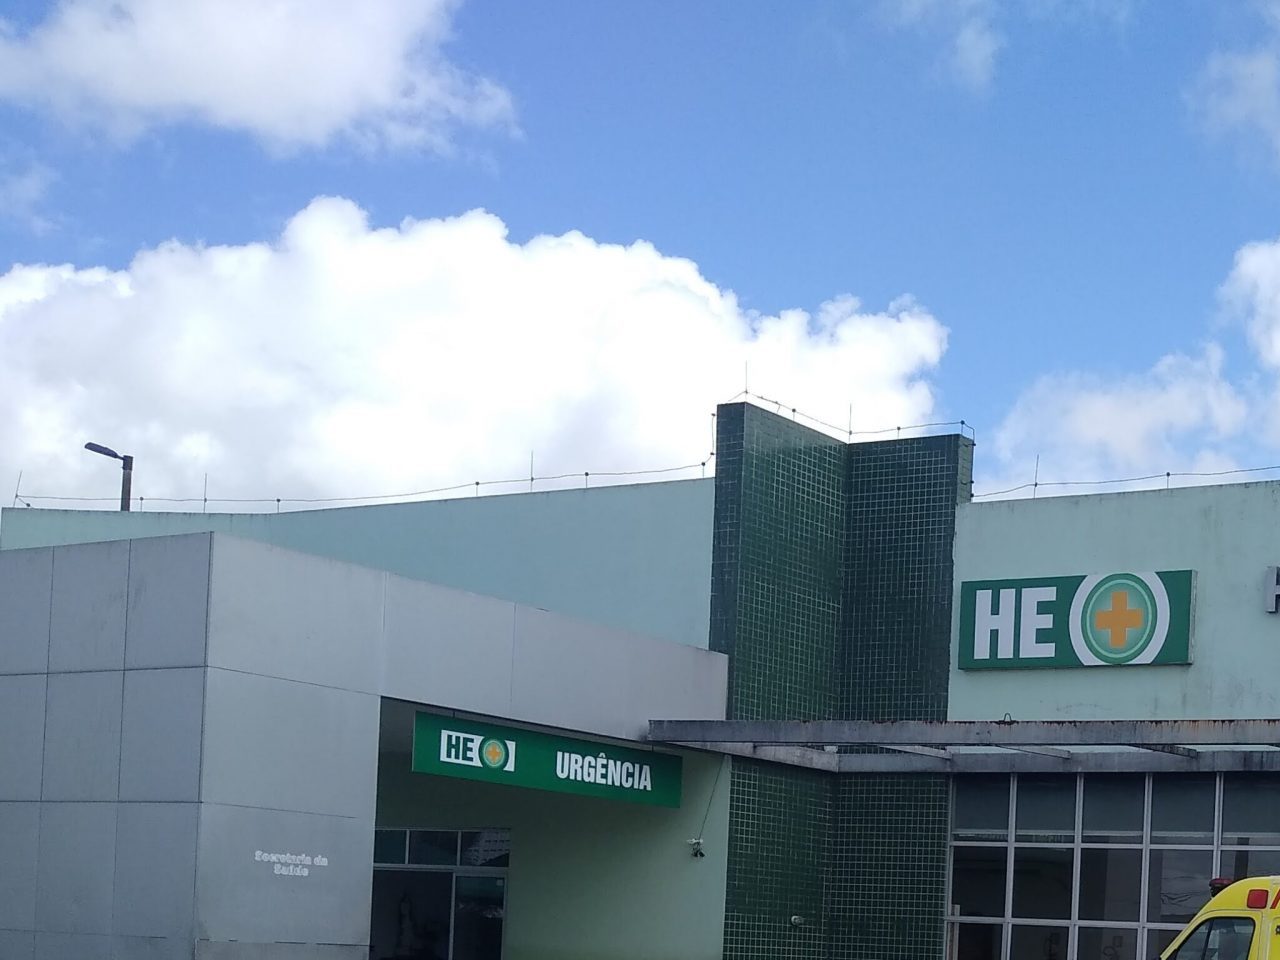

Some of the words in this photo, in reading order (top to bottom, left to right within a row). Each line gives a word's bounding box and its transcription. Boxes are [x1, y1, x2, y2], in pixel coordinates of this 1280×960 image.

[973, 586, 1057, 660] HE
[446, 734, 475, 762] HE
[556, 751, 652, 791] URGÊNCIA
